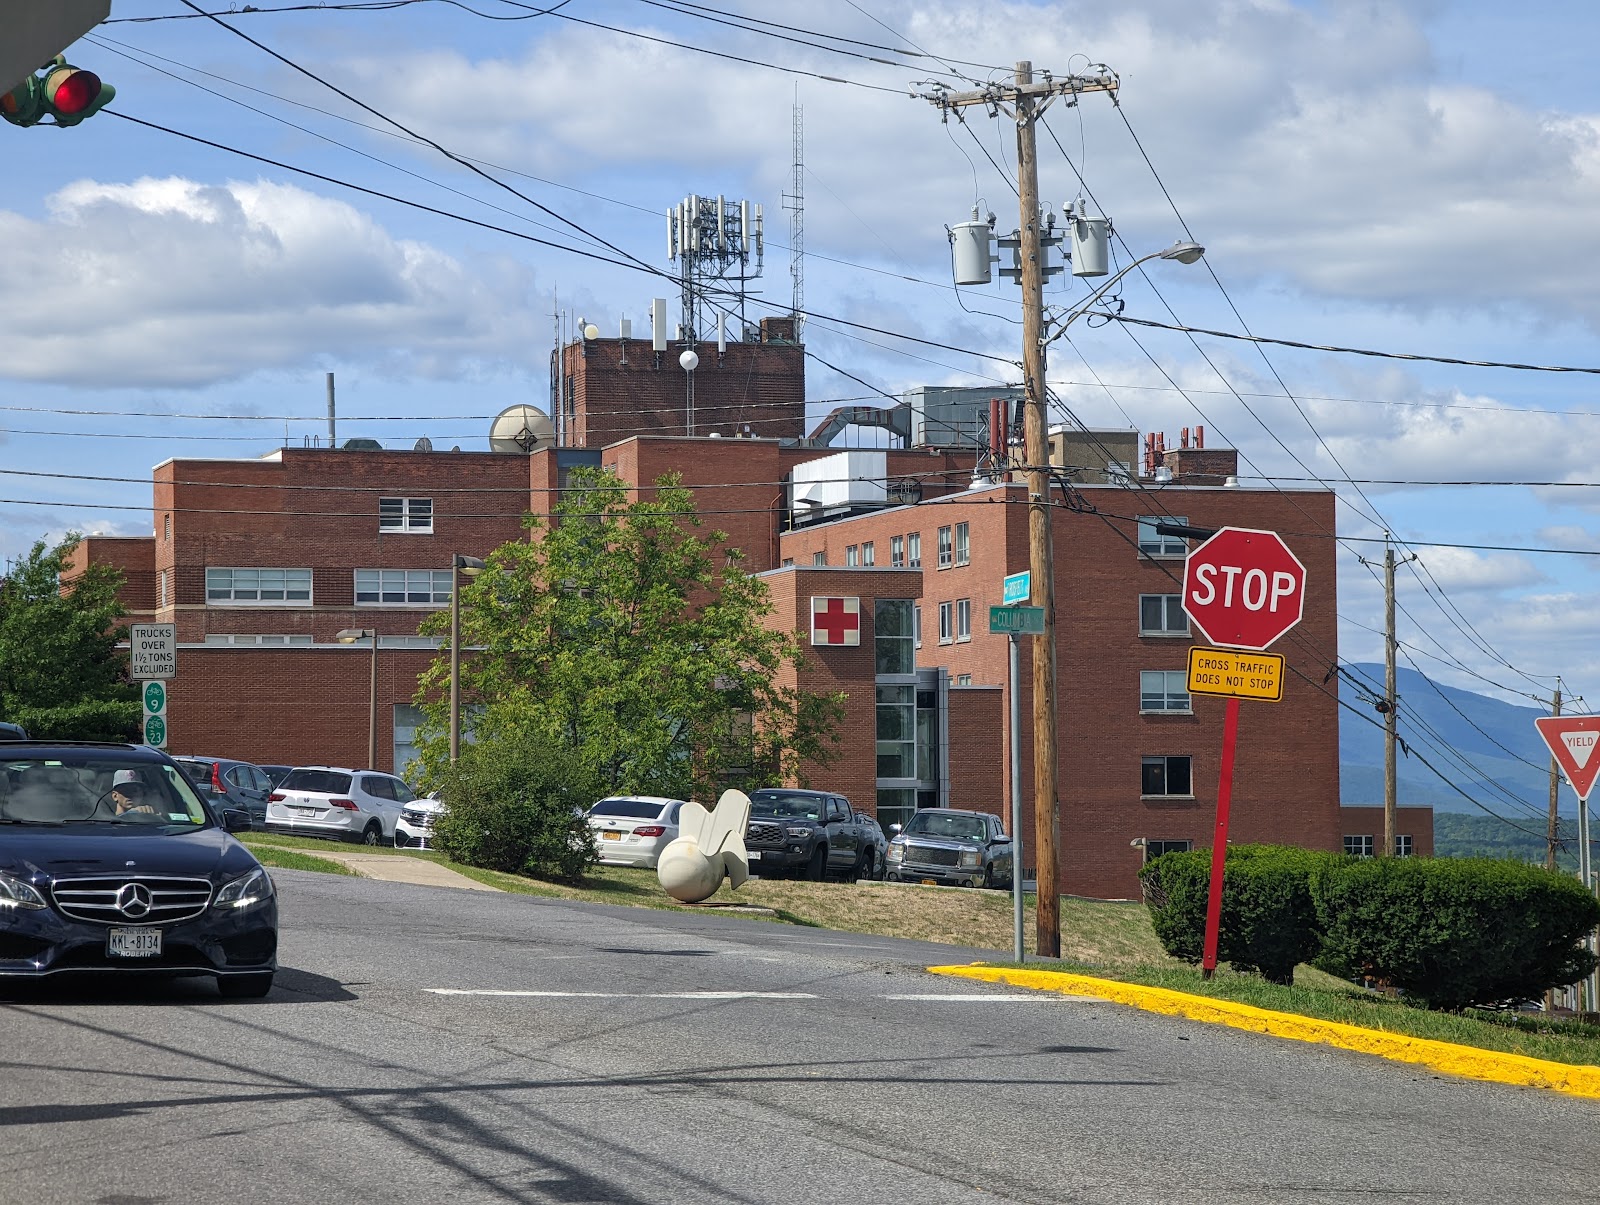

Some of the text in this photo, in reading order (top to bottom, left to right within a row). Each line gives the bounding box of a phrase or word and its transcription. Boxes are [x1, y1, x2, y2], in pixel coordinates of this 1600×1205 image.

[1192, 563, 1296, 612] STOP
[997, 611, 1031, 628] COLUMBIA
[135, 629, 172, 638] TRUCKS
[141, 641, 166, 650] OVER
[148, 653, 173, 662] TONS
[133, 664, 174, 674] EXCLUDED
[1198, 658, 1274, 675] CROSS TRAFFIC
[1195, 673, 1274, 690] DOES NOT STOP
[150, 699, 159, 710] 9
[150, 732, 161, 743] 23
[1566, 737, 1594, 747] YIELD
